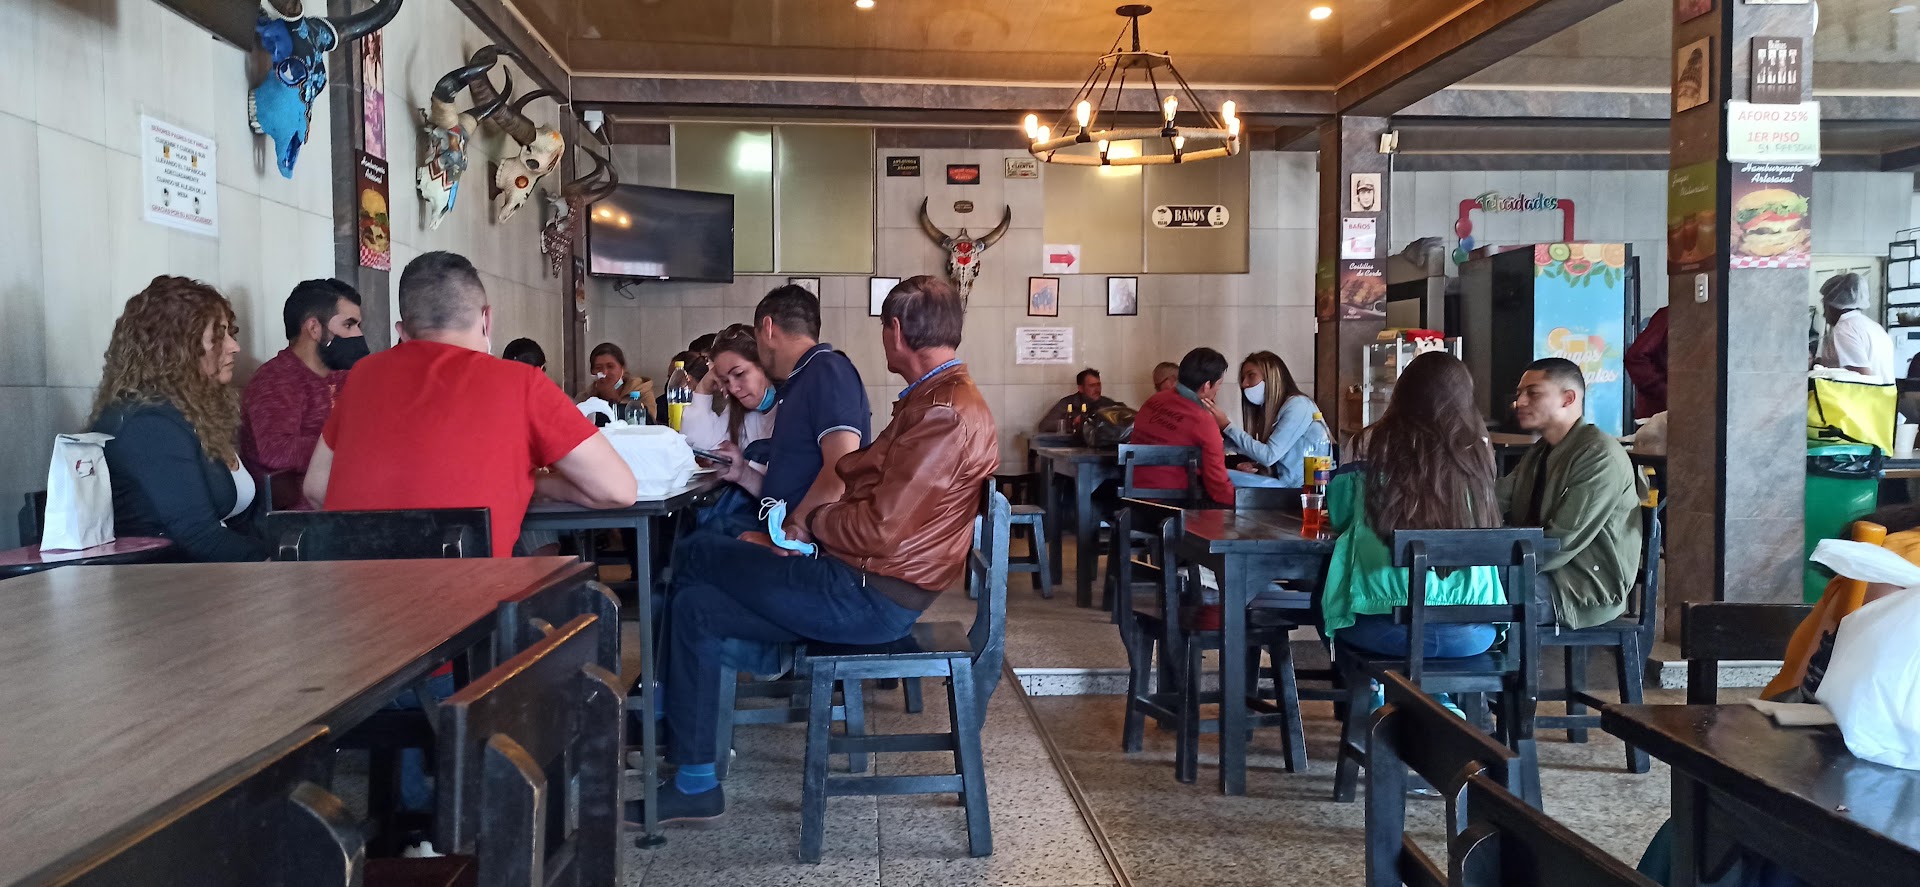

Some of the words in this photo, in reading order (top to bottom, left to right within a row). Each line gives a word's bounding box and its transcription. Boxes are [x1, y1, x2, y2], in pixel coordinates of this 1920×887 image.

[1738, 111, 1780, 121] AFORO
[1783, 111, 1809, 121] 25%
[1747, 132, 1769, 142] 1ER
[1772, 132, 1800, 142] PISO
[1741, 162, 1804, 176] Hamburguesa
[1750, 172, 1795, 183] Artesanal
[1475, 190, 1558, 212] Felicidades
[1174, 207, 1205, 222] BAÑOS
[1349, 262, 1374, 270] Costillas
[1356, 269, 1364, 277] de
[1364, 269, 1382, 277] Cerdo
